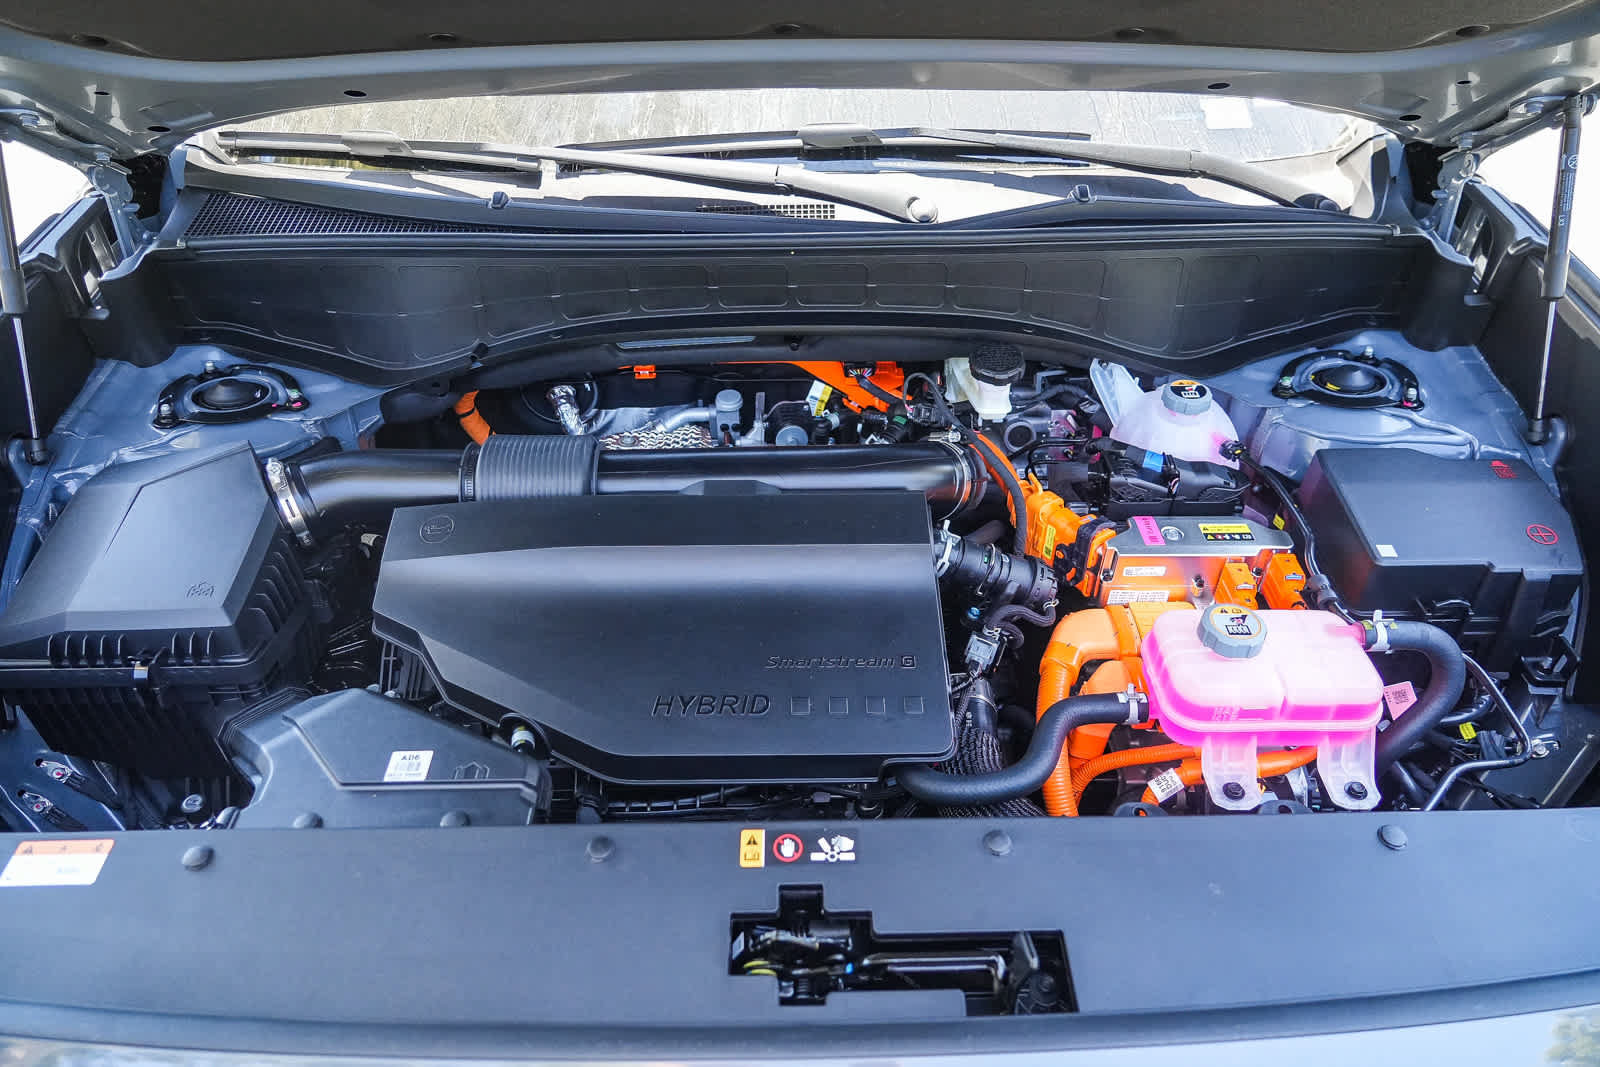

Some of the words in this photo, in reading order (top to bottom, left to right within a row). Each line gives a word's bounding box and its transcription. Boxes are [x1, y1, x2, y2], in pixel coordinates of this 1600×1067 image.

[765, 656, 895, 669] Smartstream
[901, 655, 917, 669] G
[651, 695, 771, 717] HYBRID
